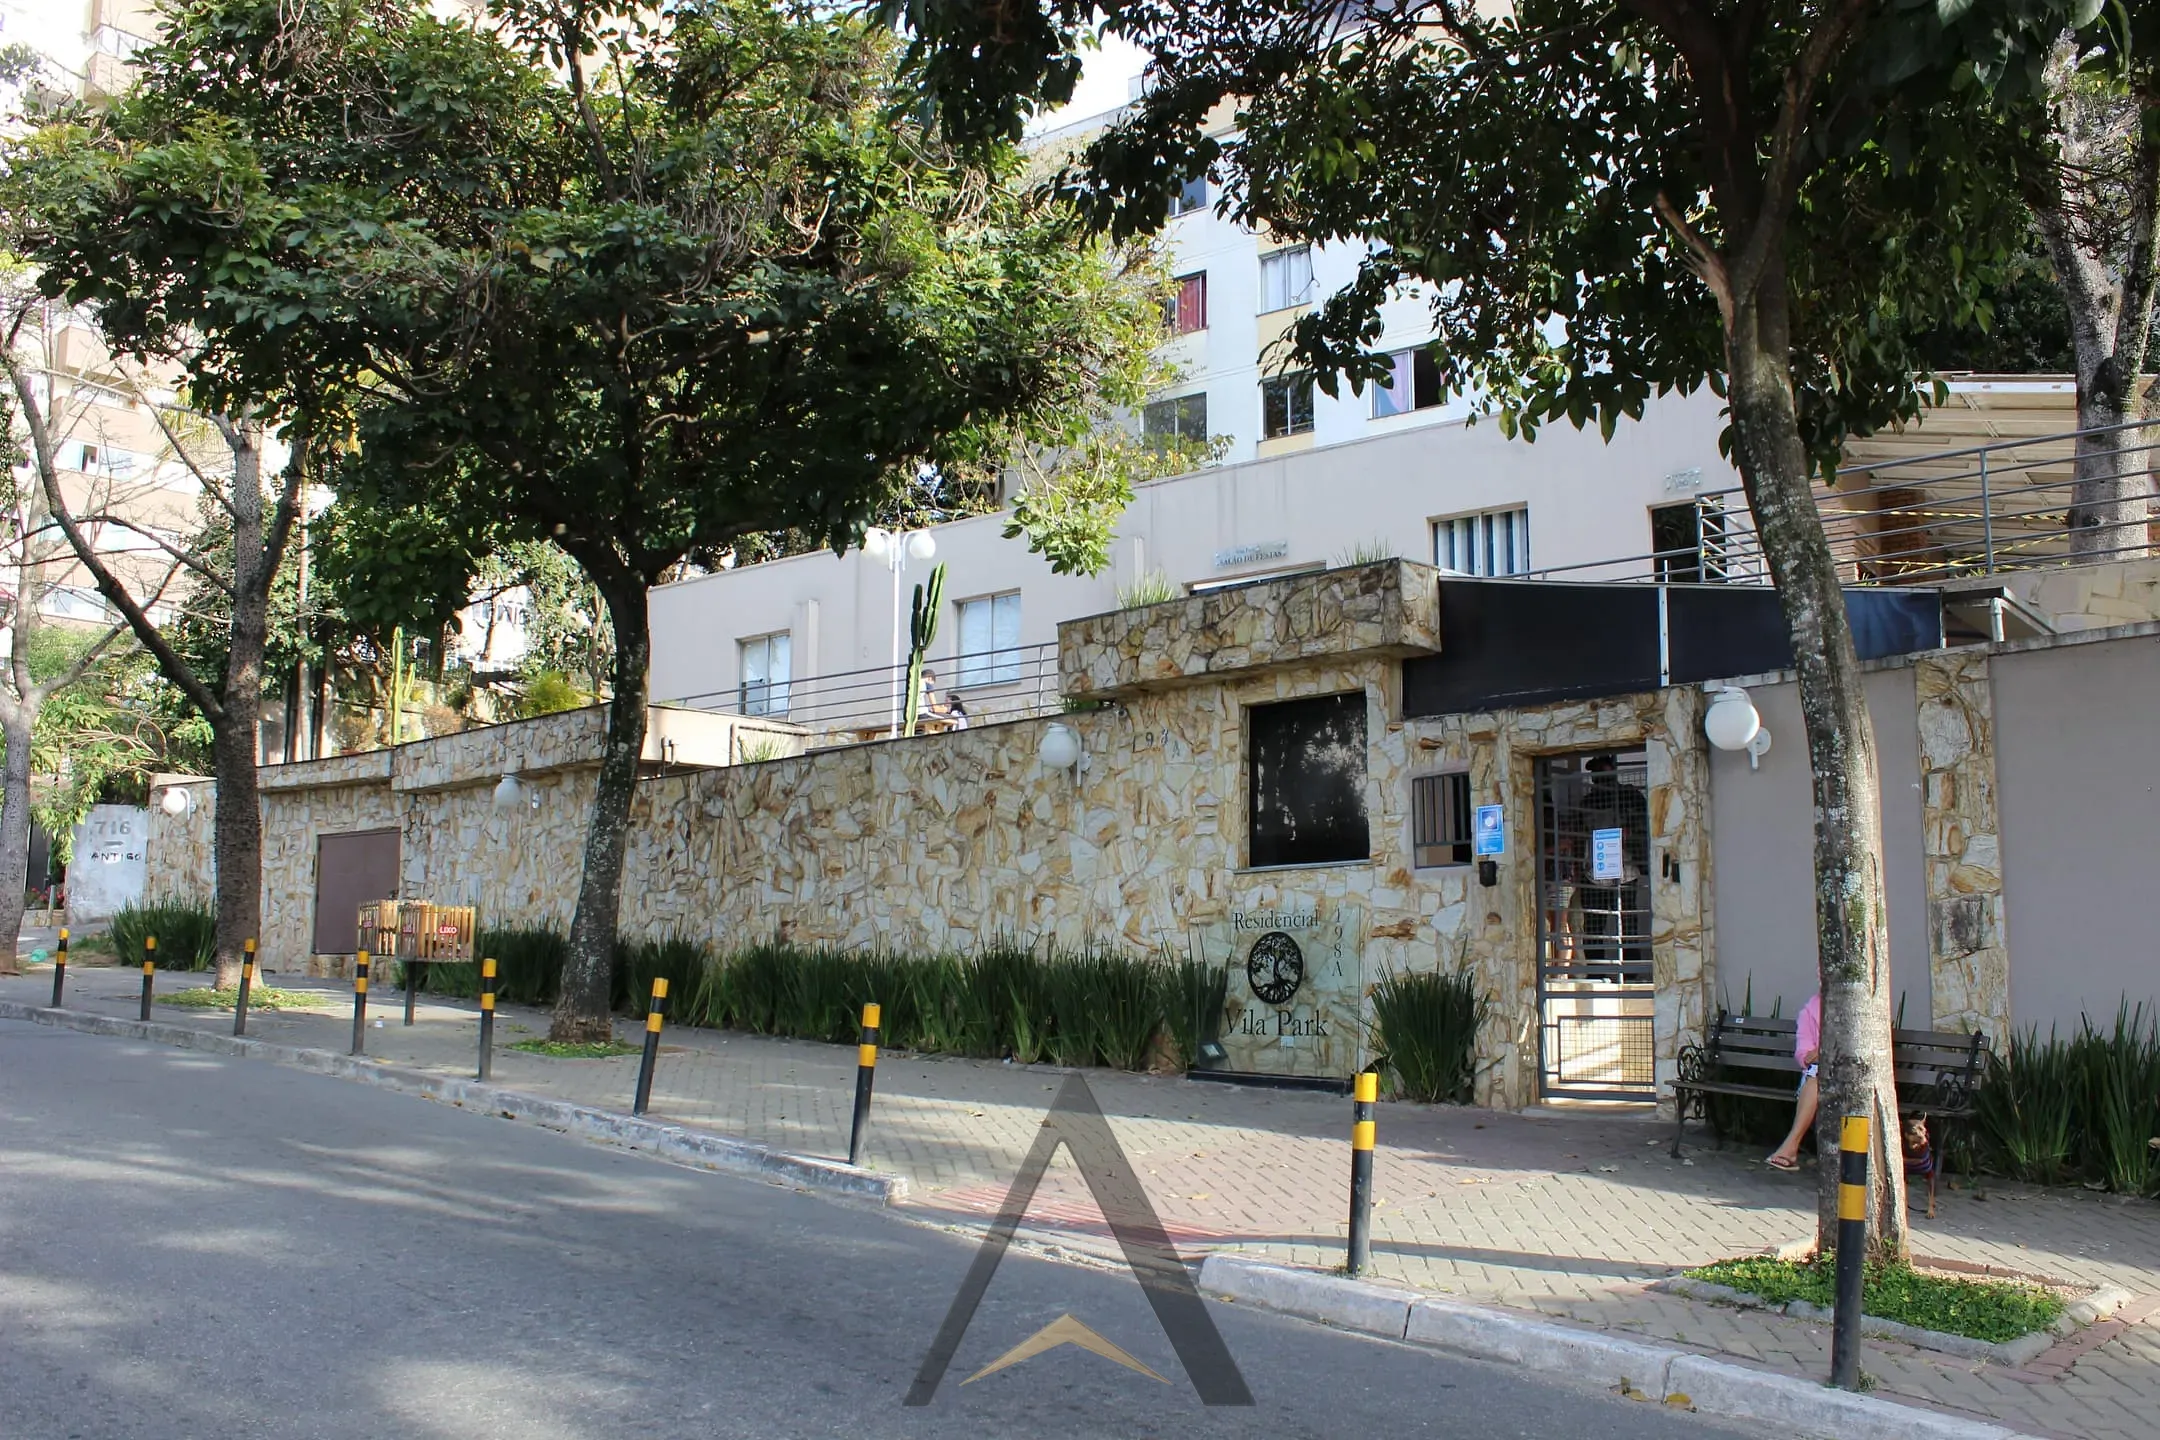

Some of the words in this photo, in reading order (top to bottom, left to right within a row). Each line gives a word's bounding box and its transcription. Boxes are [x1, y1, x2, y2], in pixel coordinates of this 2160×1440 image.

[94, 820, 132, 835] 716
[91, 852, 141, 861] ANTIGO
[1234, 908, 1319, 930] Residencial
[440, 926, 458, 934] LIXO
[1225, 1007, 1267, 1036] Vila
[1277, 1009, 1329, 1037] Park
